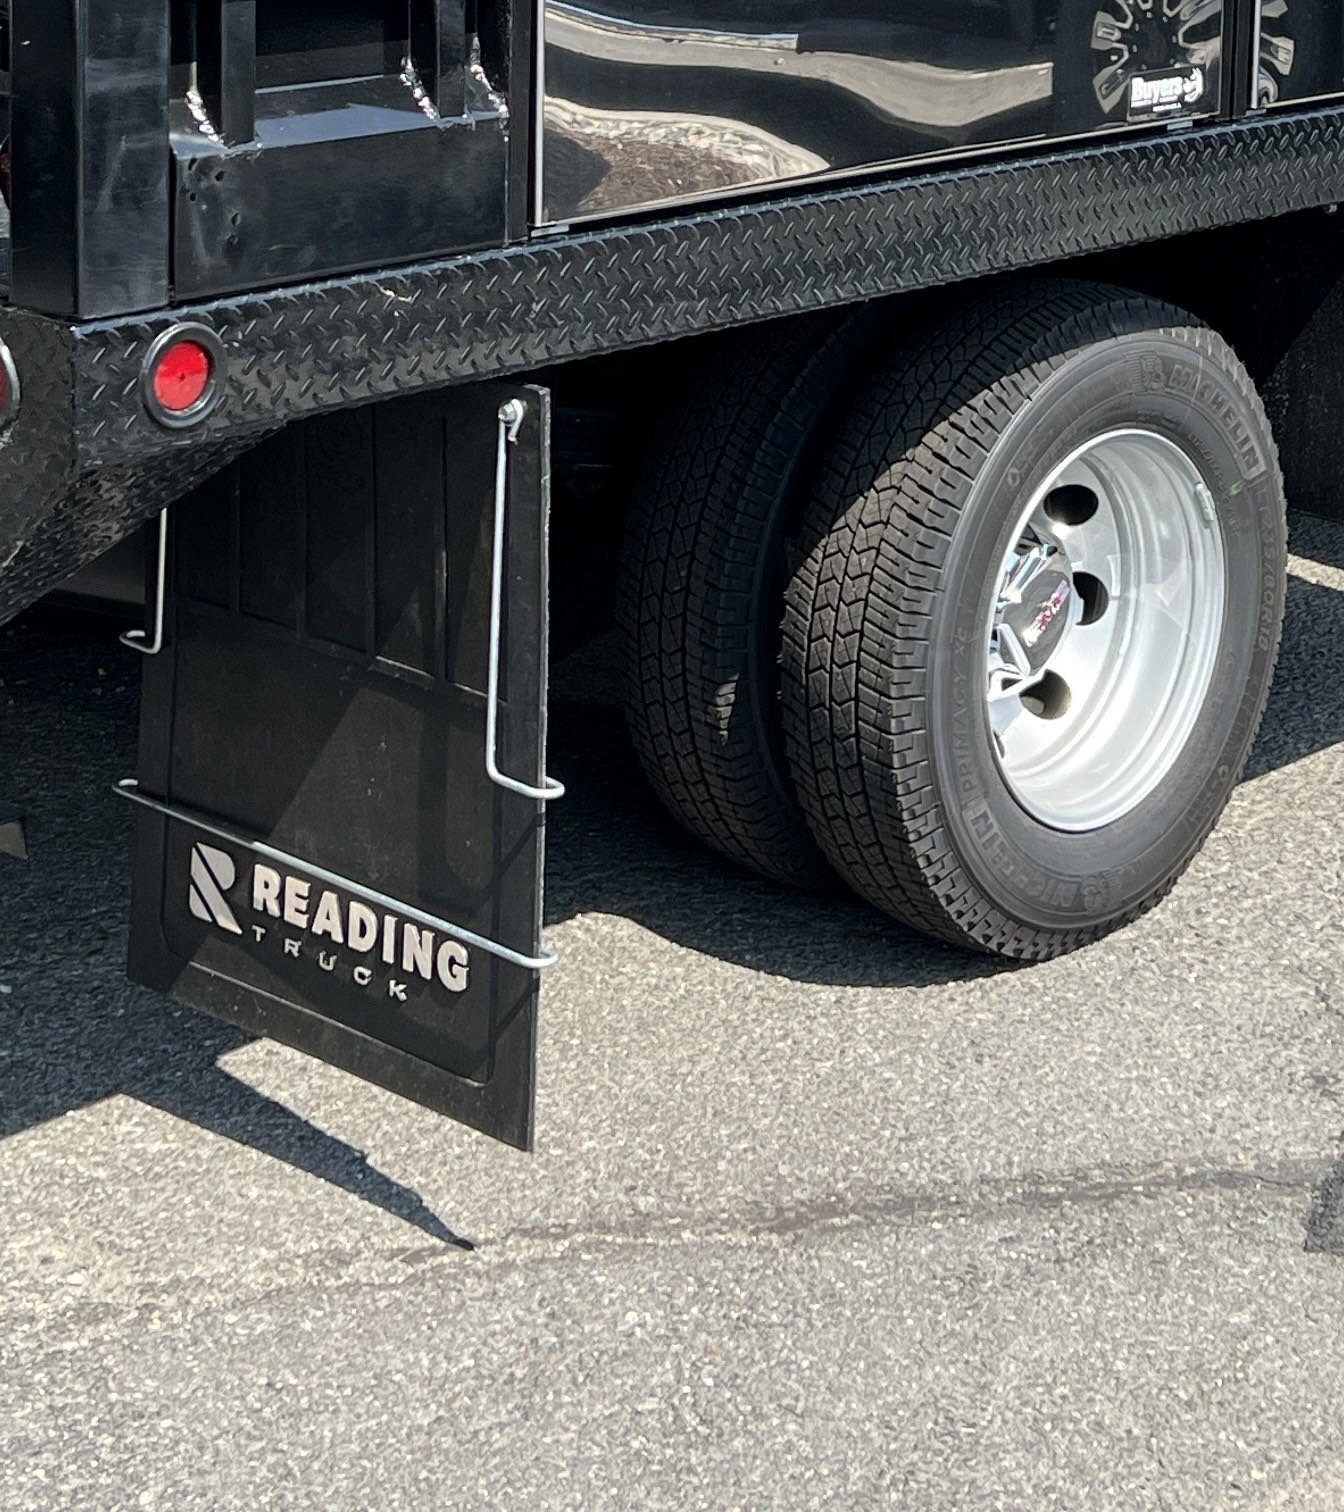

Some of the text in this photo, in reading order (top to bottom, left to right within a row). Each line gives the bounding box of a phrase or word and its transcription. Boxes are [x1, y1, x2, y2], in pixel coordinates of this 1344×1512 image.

[1131, 76, 1183, 104] Buyers
[1168, 364, 1261, 476] MICHELIN
[251, 924, 408, 1001] TRUCK
[253, 863, 470, 992] READING
